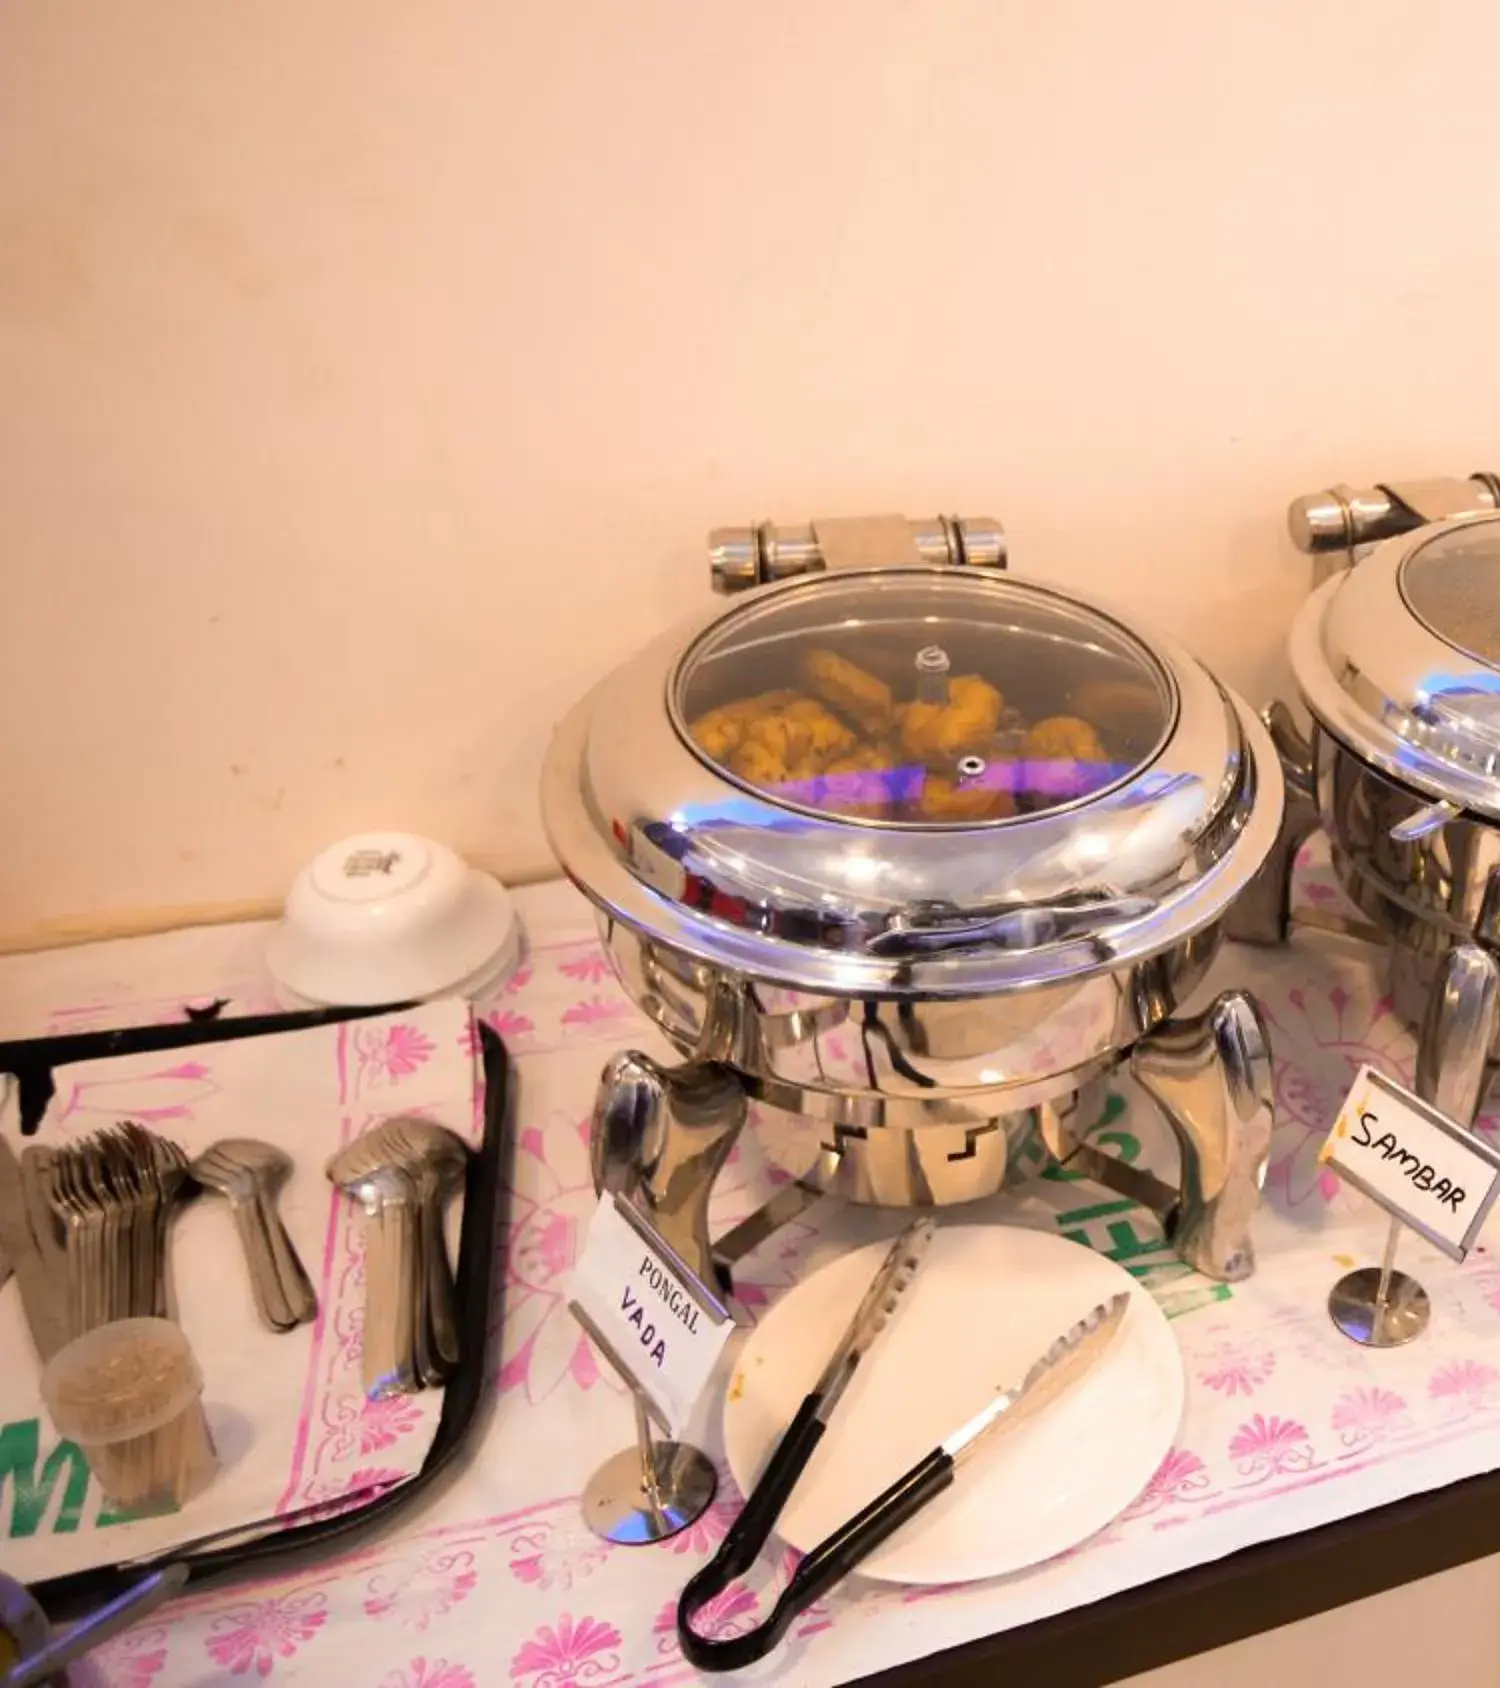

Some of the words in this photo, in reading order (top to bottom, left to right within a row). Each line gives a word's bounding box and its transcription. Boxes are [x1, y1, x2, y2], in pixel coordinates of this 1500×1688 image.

[1350, 1112, 1467, 1215] SAMBAR
[620, 1286, 666, 1368] VADA
[639, 1256, 699, 1335] PONGAL
